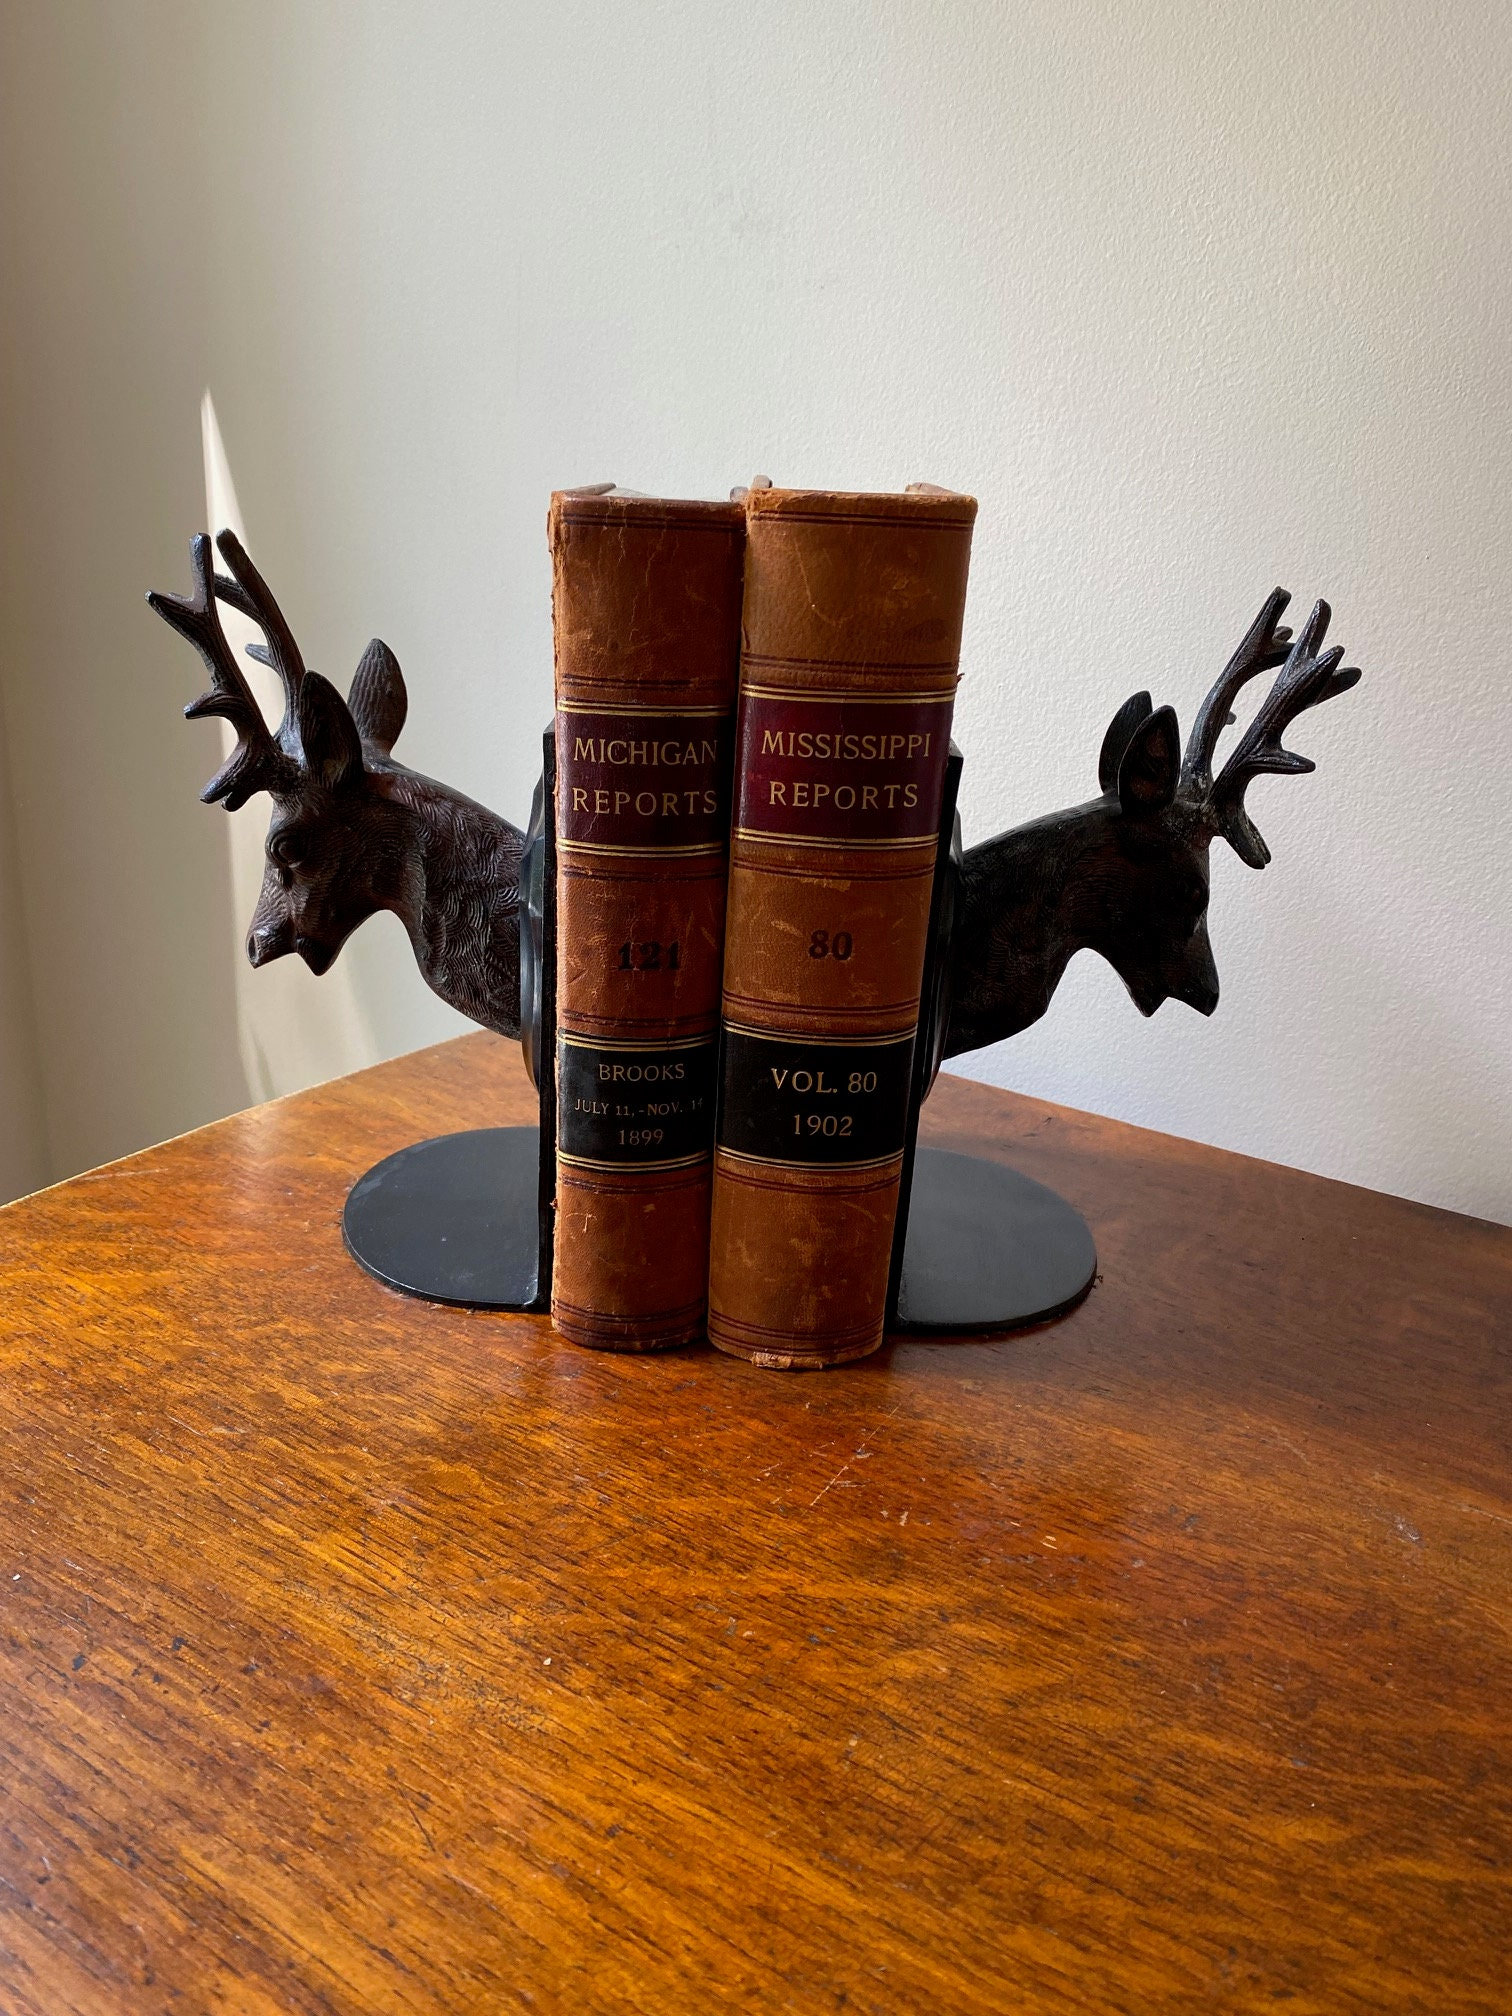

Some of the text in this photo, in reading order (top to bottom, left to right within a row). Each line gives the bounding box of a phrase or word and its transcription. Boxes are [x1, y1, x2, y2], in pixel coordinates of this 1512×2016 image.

[573, 737, 718, 766] MICHIGAN
[761, 730, 931, 760] MISSISSIPPI
[572, 787, 717, 816] REPORTS
[769, 780, 918, 810] REPORTS
[617, 940, 680, 971] 121
[808, 929, 853, 960] 80
[599, 1063, 685, 1082] BROOKS
[770, 1068, 877, 1094] VOL. 80
[574, 1099, 610, 1116] JULY
[618, 1128, 664, 1146] 1899
[793, 1114, 853, 1136] 1902
